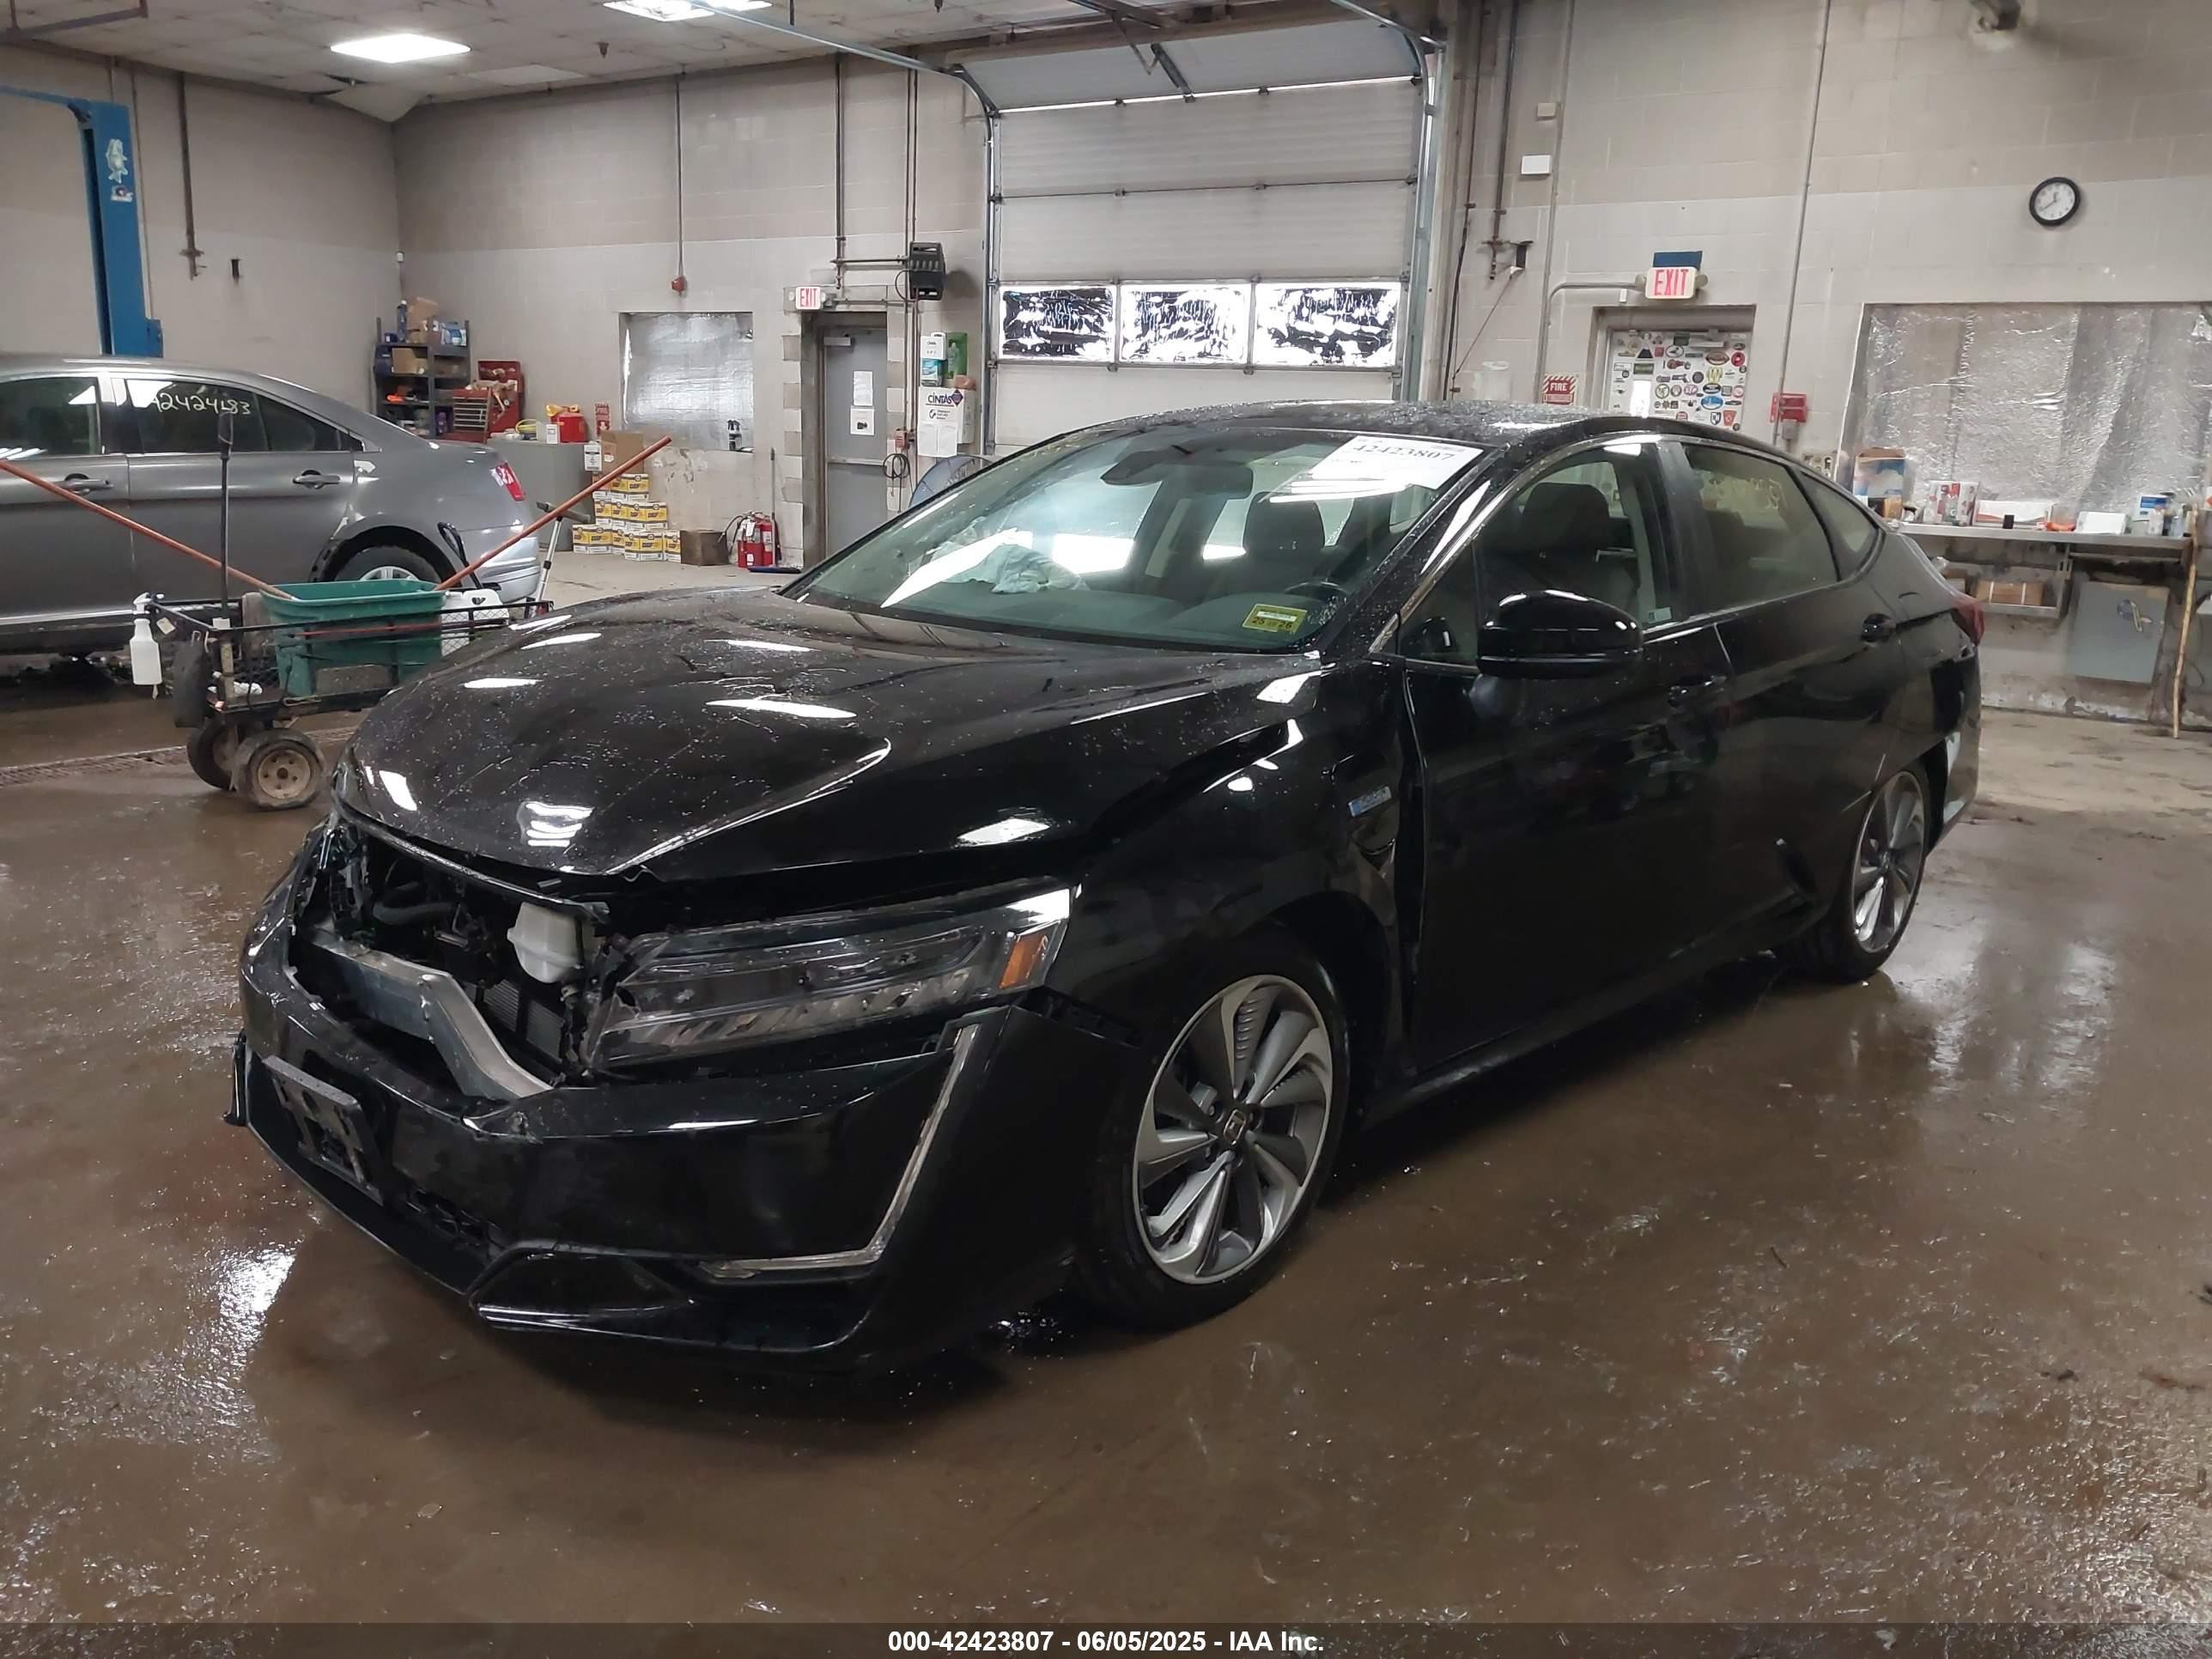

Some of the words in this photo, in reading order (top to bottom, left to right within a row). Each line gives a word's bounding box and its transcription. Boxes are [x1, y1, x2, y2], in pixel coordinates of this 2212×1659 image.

[1654, 269, 1689, 296] EXIT
[799, 288, 817, 307] EXIT
[1550, 382, 1568, 392] FIRE
[1353, 444, 1455, 460] 42423807
